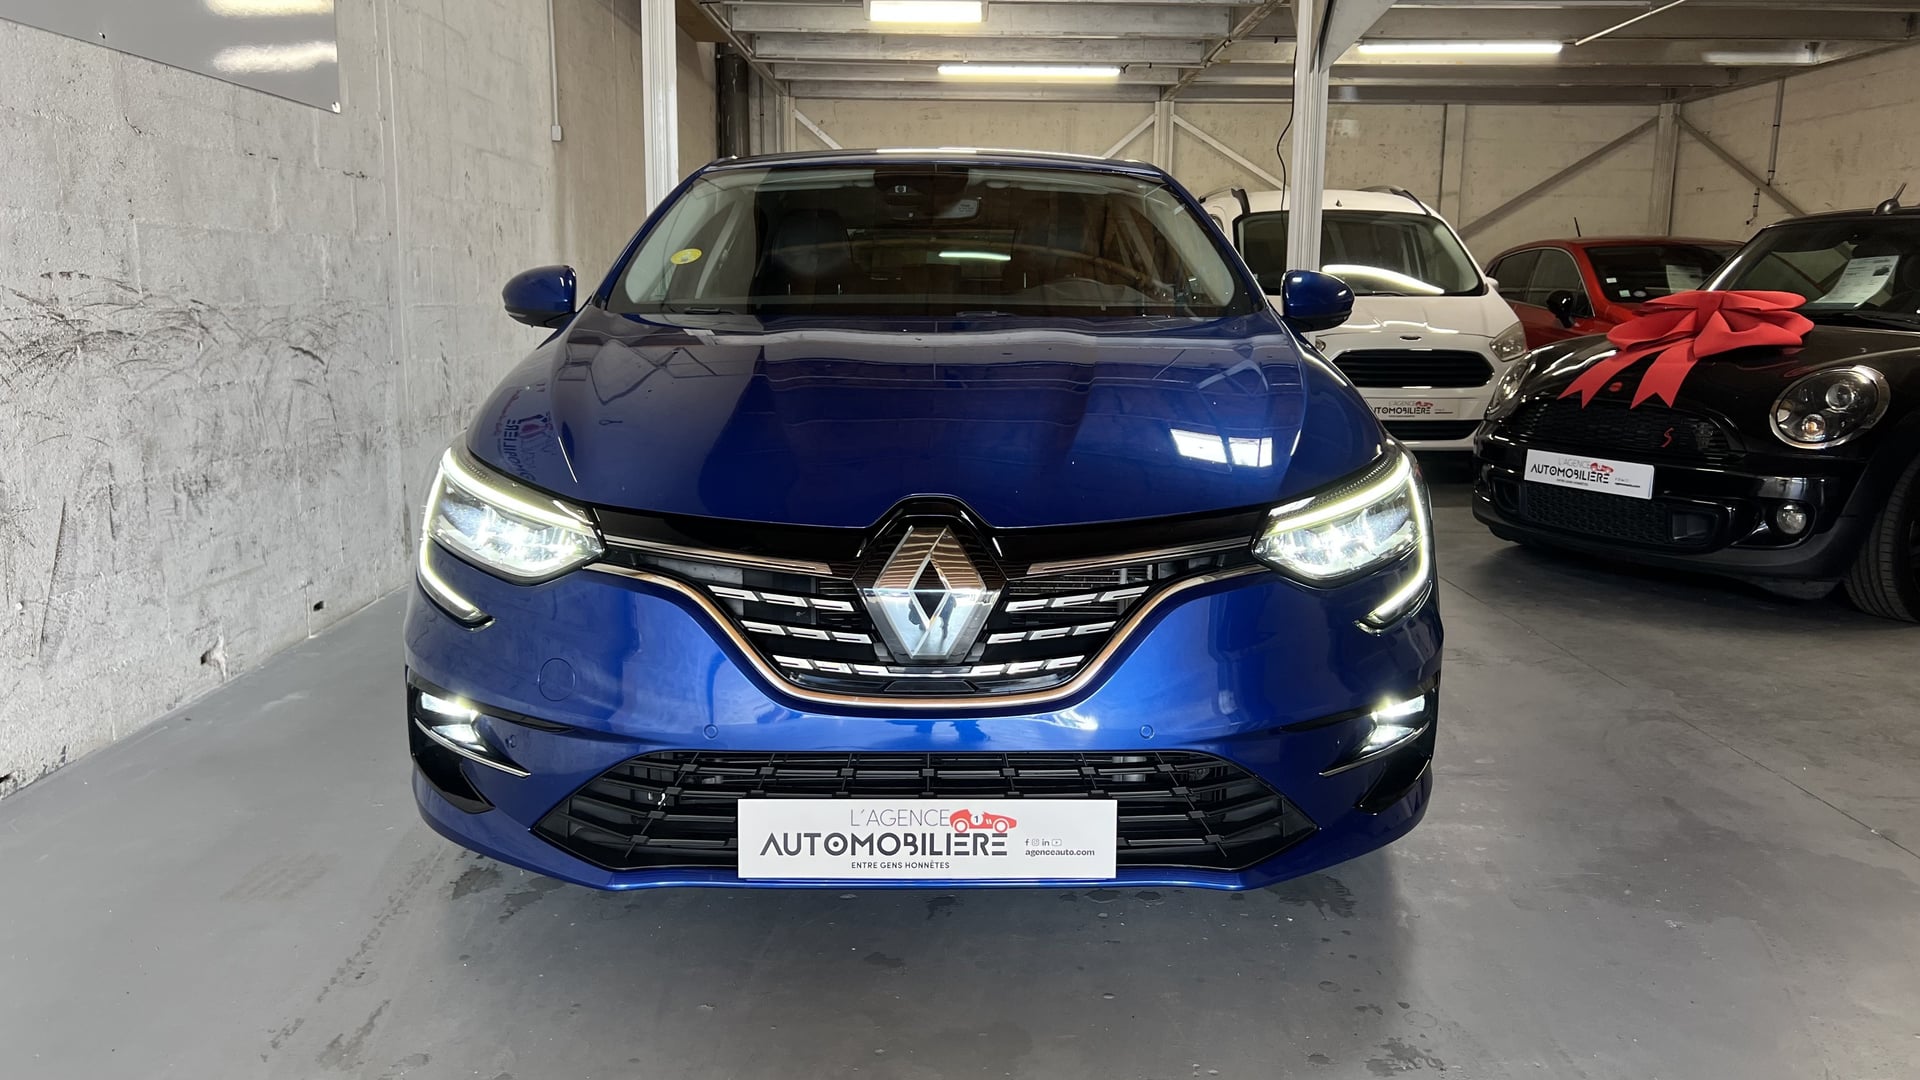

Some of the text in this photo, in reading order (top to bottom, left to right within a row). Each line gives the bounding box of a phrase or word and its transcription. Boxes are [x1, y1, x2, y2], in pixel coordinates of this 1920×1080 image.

[850, 808, 950, 827] L'AGENCE
[1024, 848, 1096, 858] agenceauto.com
[851, 859, 951, 869] ENTRE GENS HONNÊTES
